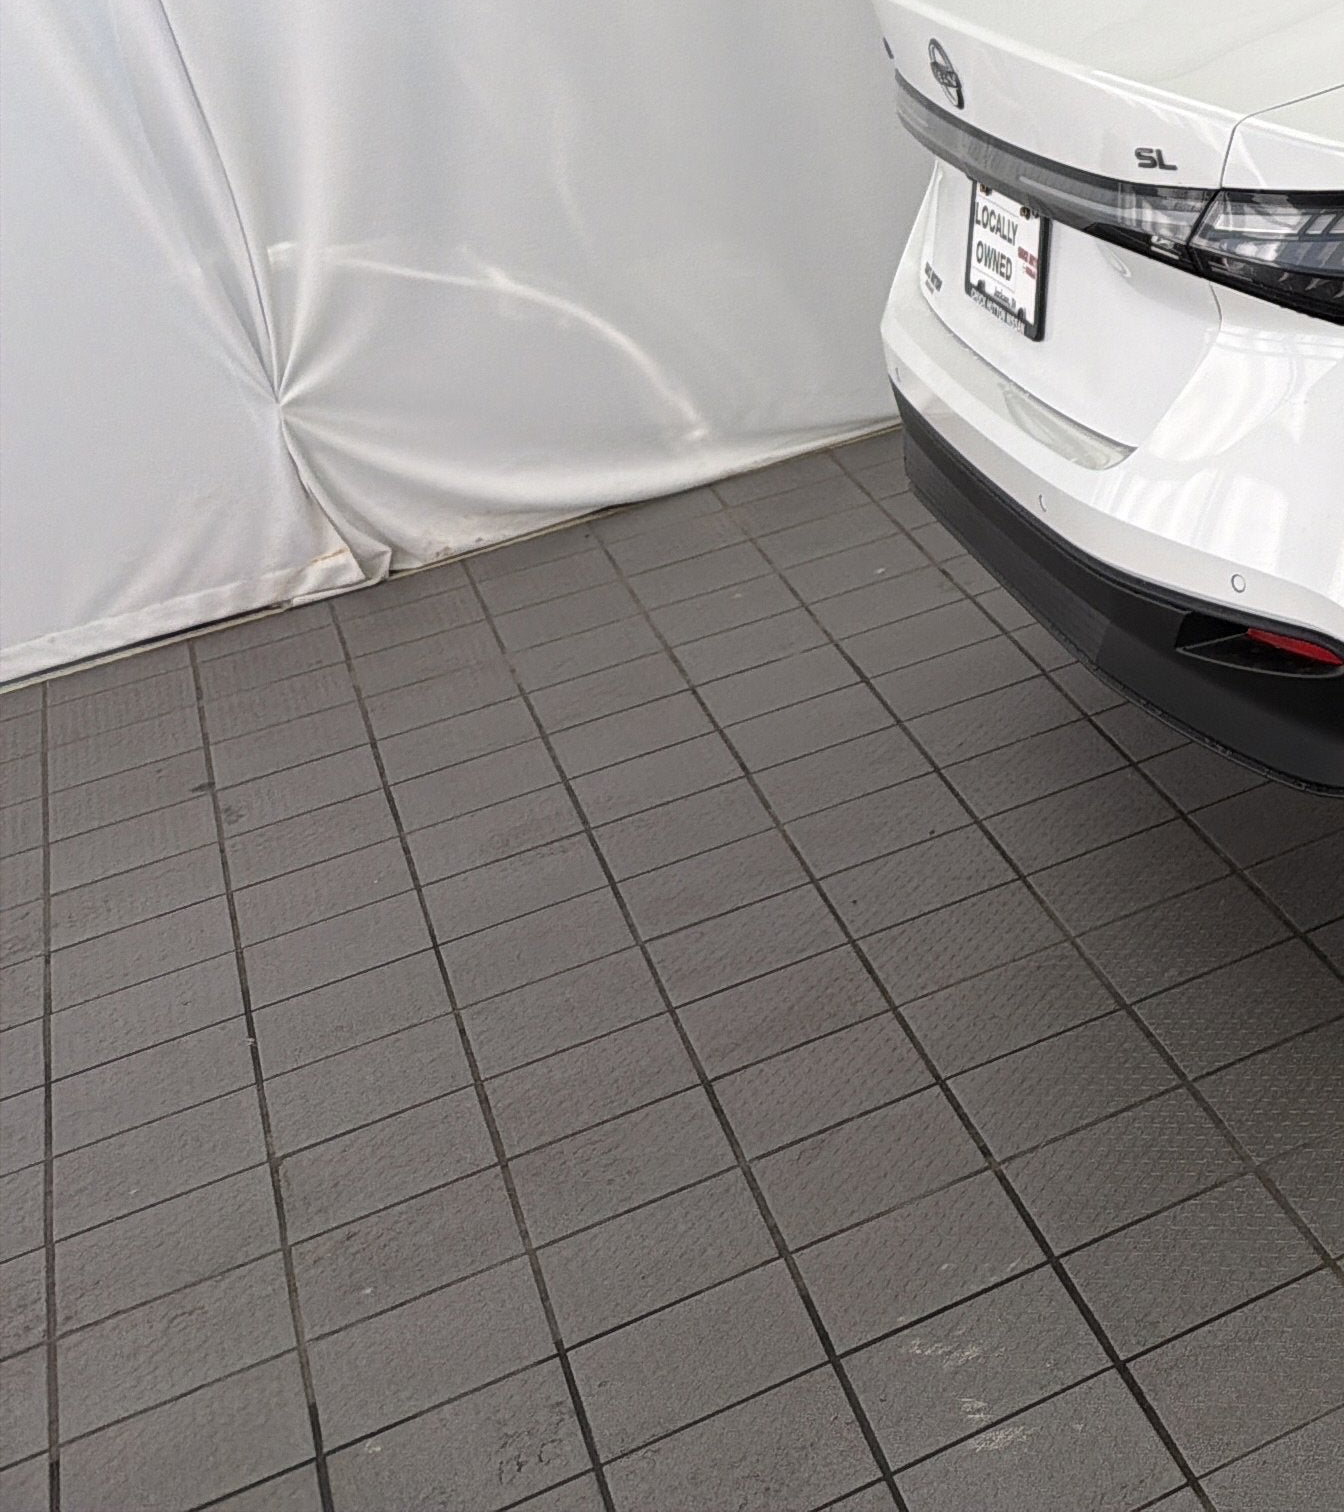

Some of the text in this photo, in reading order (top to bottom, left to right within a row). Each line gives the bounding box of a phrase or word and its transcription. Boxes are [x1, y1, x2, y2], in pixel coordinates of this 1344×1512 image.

[1134, 147, 1178, 171] SL
[975, 202, 1019, 246] LOCALLY
[976, 240, 1013, 282] OWNED
